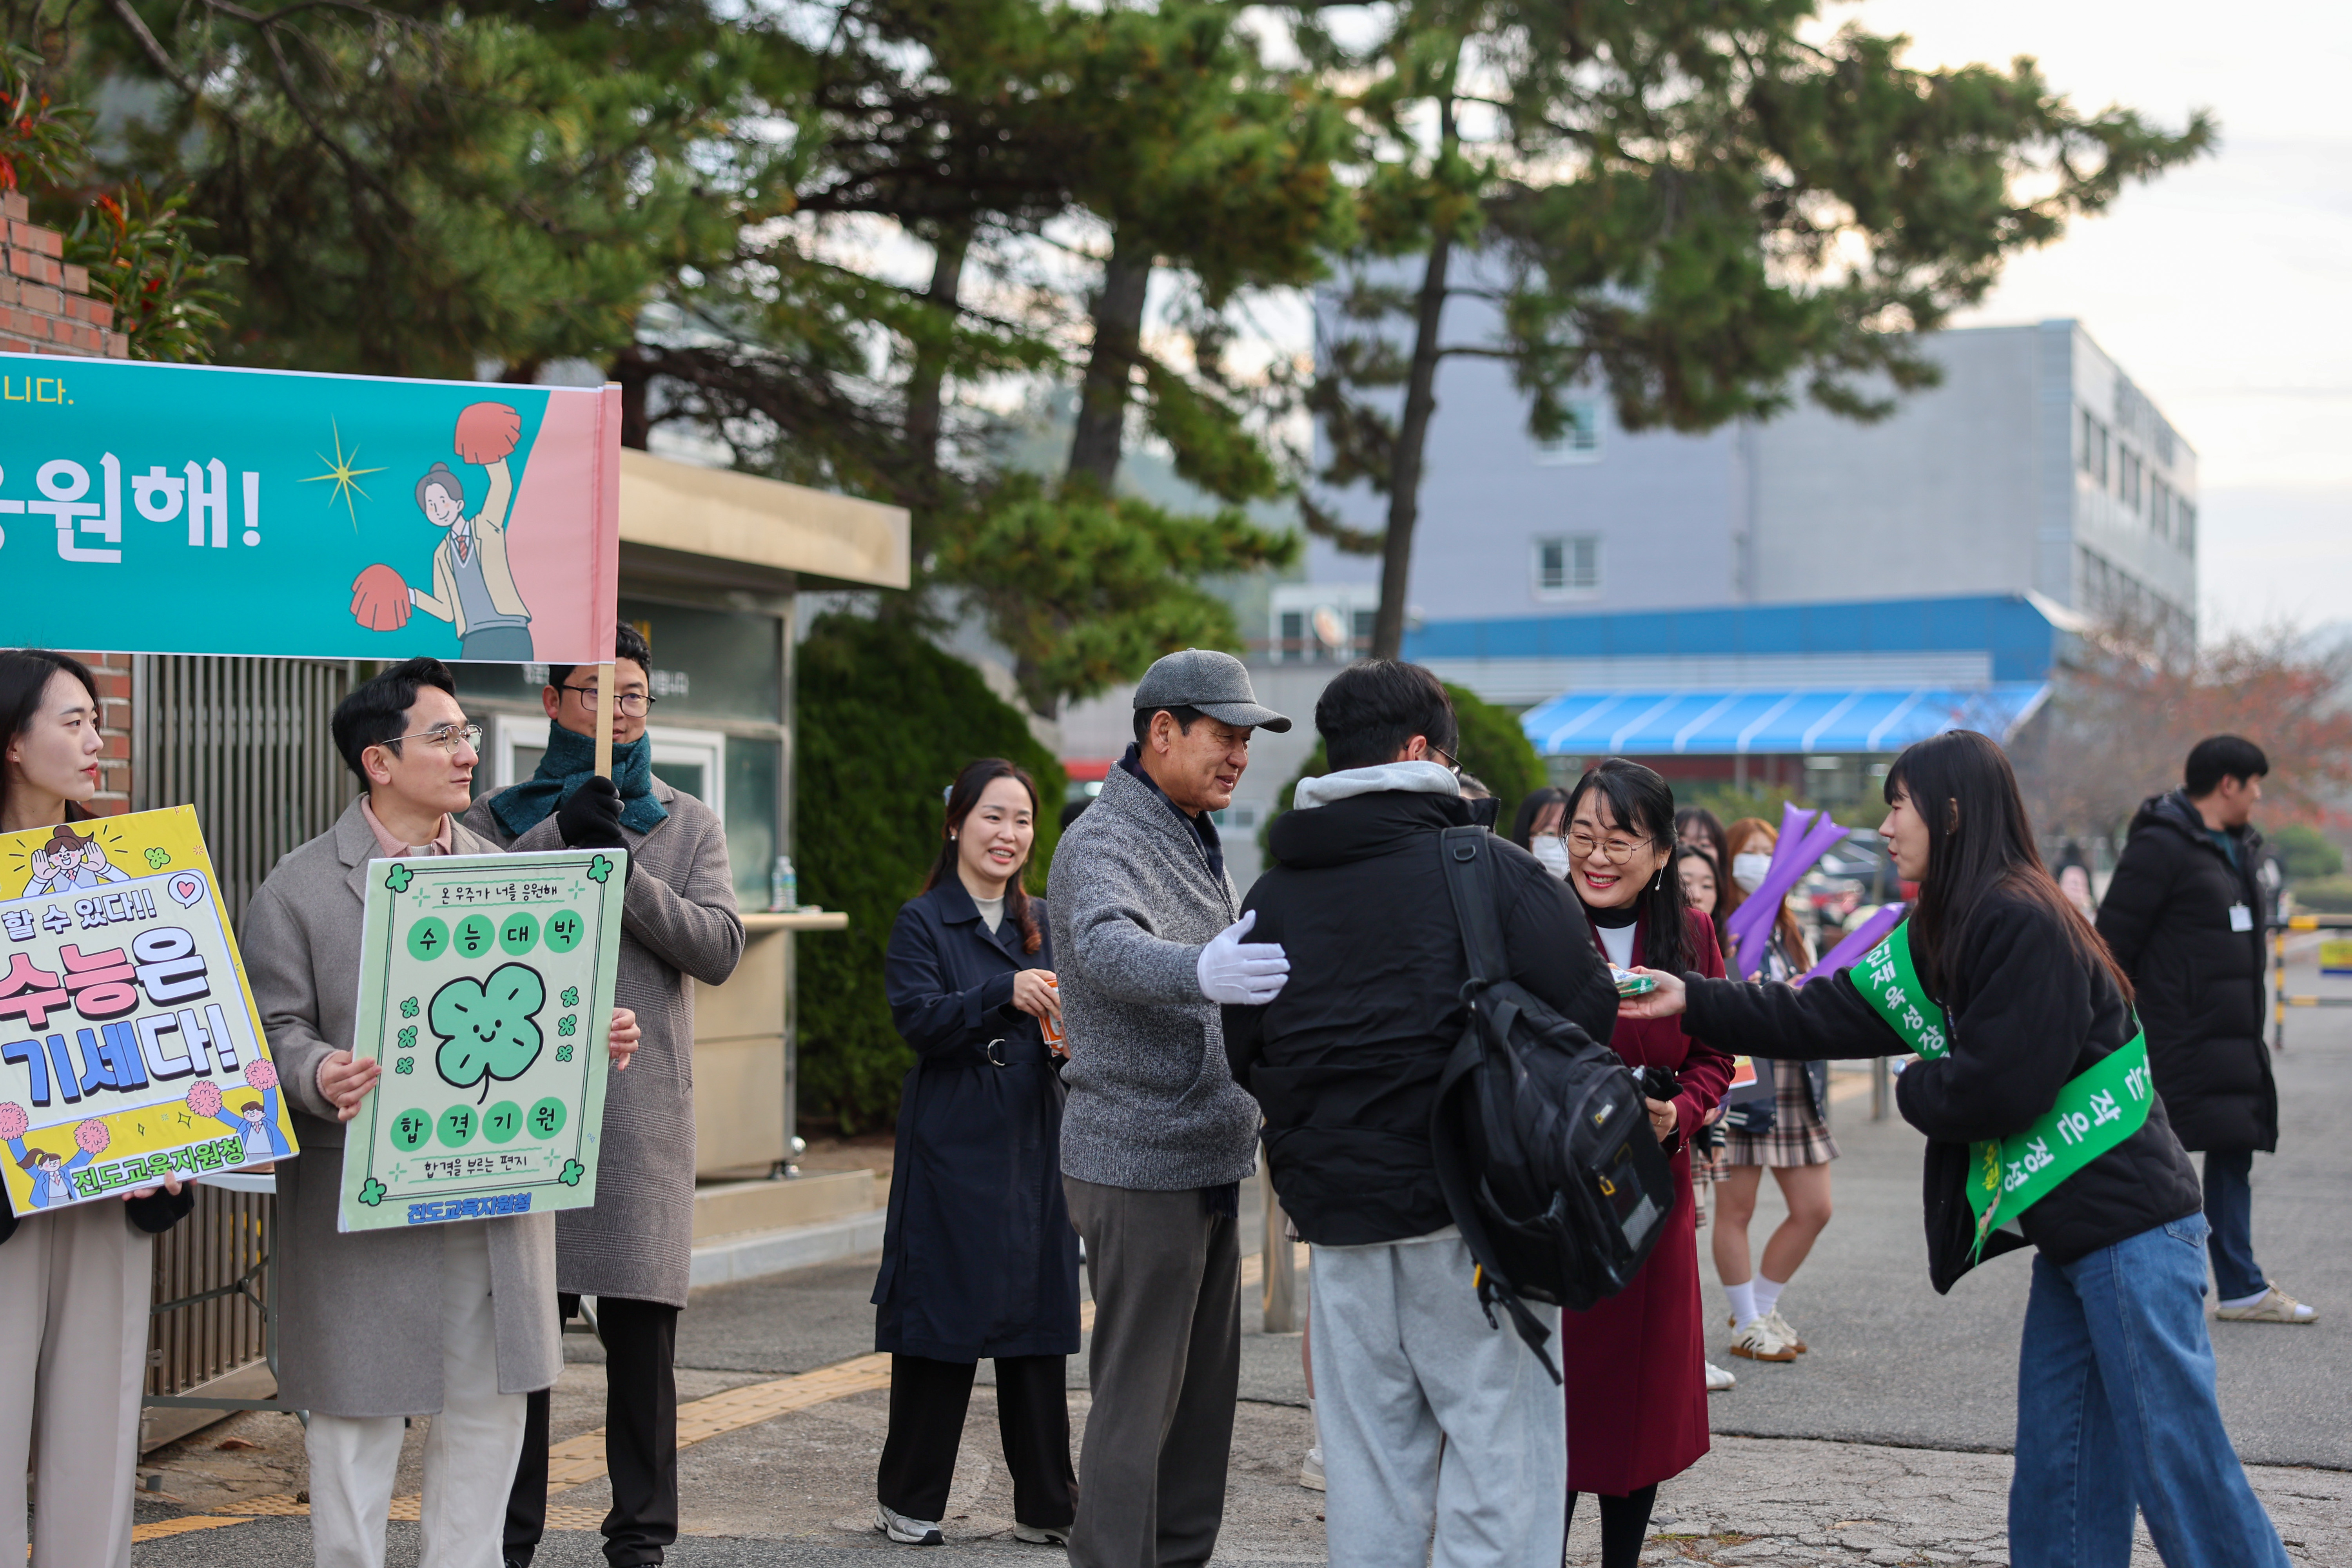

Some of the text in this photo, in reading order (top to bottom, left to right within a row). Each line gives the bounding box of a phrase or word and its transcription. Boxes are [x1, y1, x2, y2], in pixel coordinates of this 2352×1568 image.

[4, 376, 74, 405] 니다.
[0, 451, 260, 563] 원해!
[1, 889, 157, 942] 할 수 있다!!
[442, 883, 557, 904] 온 우주가 너를 응원해
[0, 926, 210, 1031] 수능은
[1, 1004, 240, 1107] 기세다!
[2056, 1089, 2122, 1145] 작은
[73, 1137, 245, 1197] 진도교육지원청
[425, 1155, 527, 1179] 합격을 부르는 편지
[2004, 1136, 2055, 1192] 정성
[408, 1192, 532, 1224] 진도교육지원청
